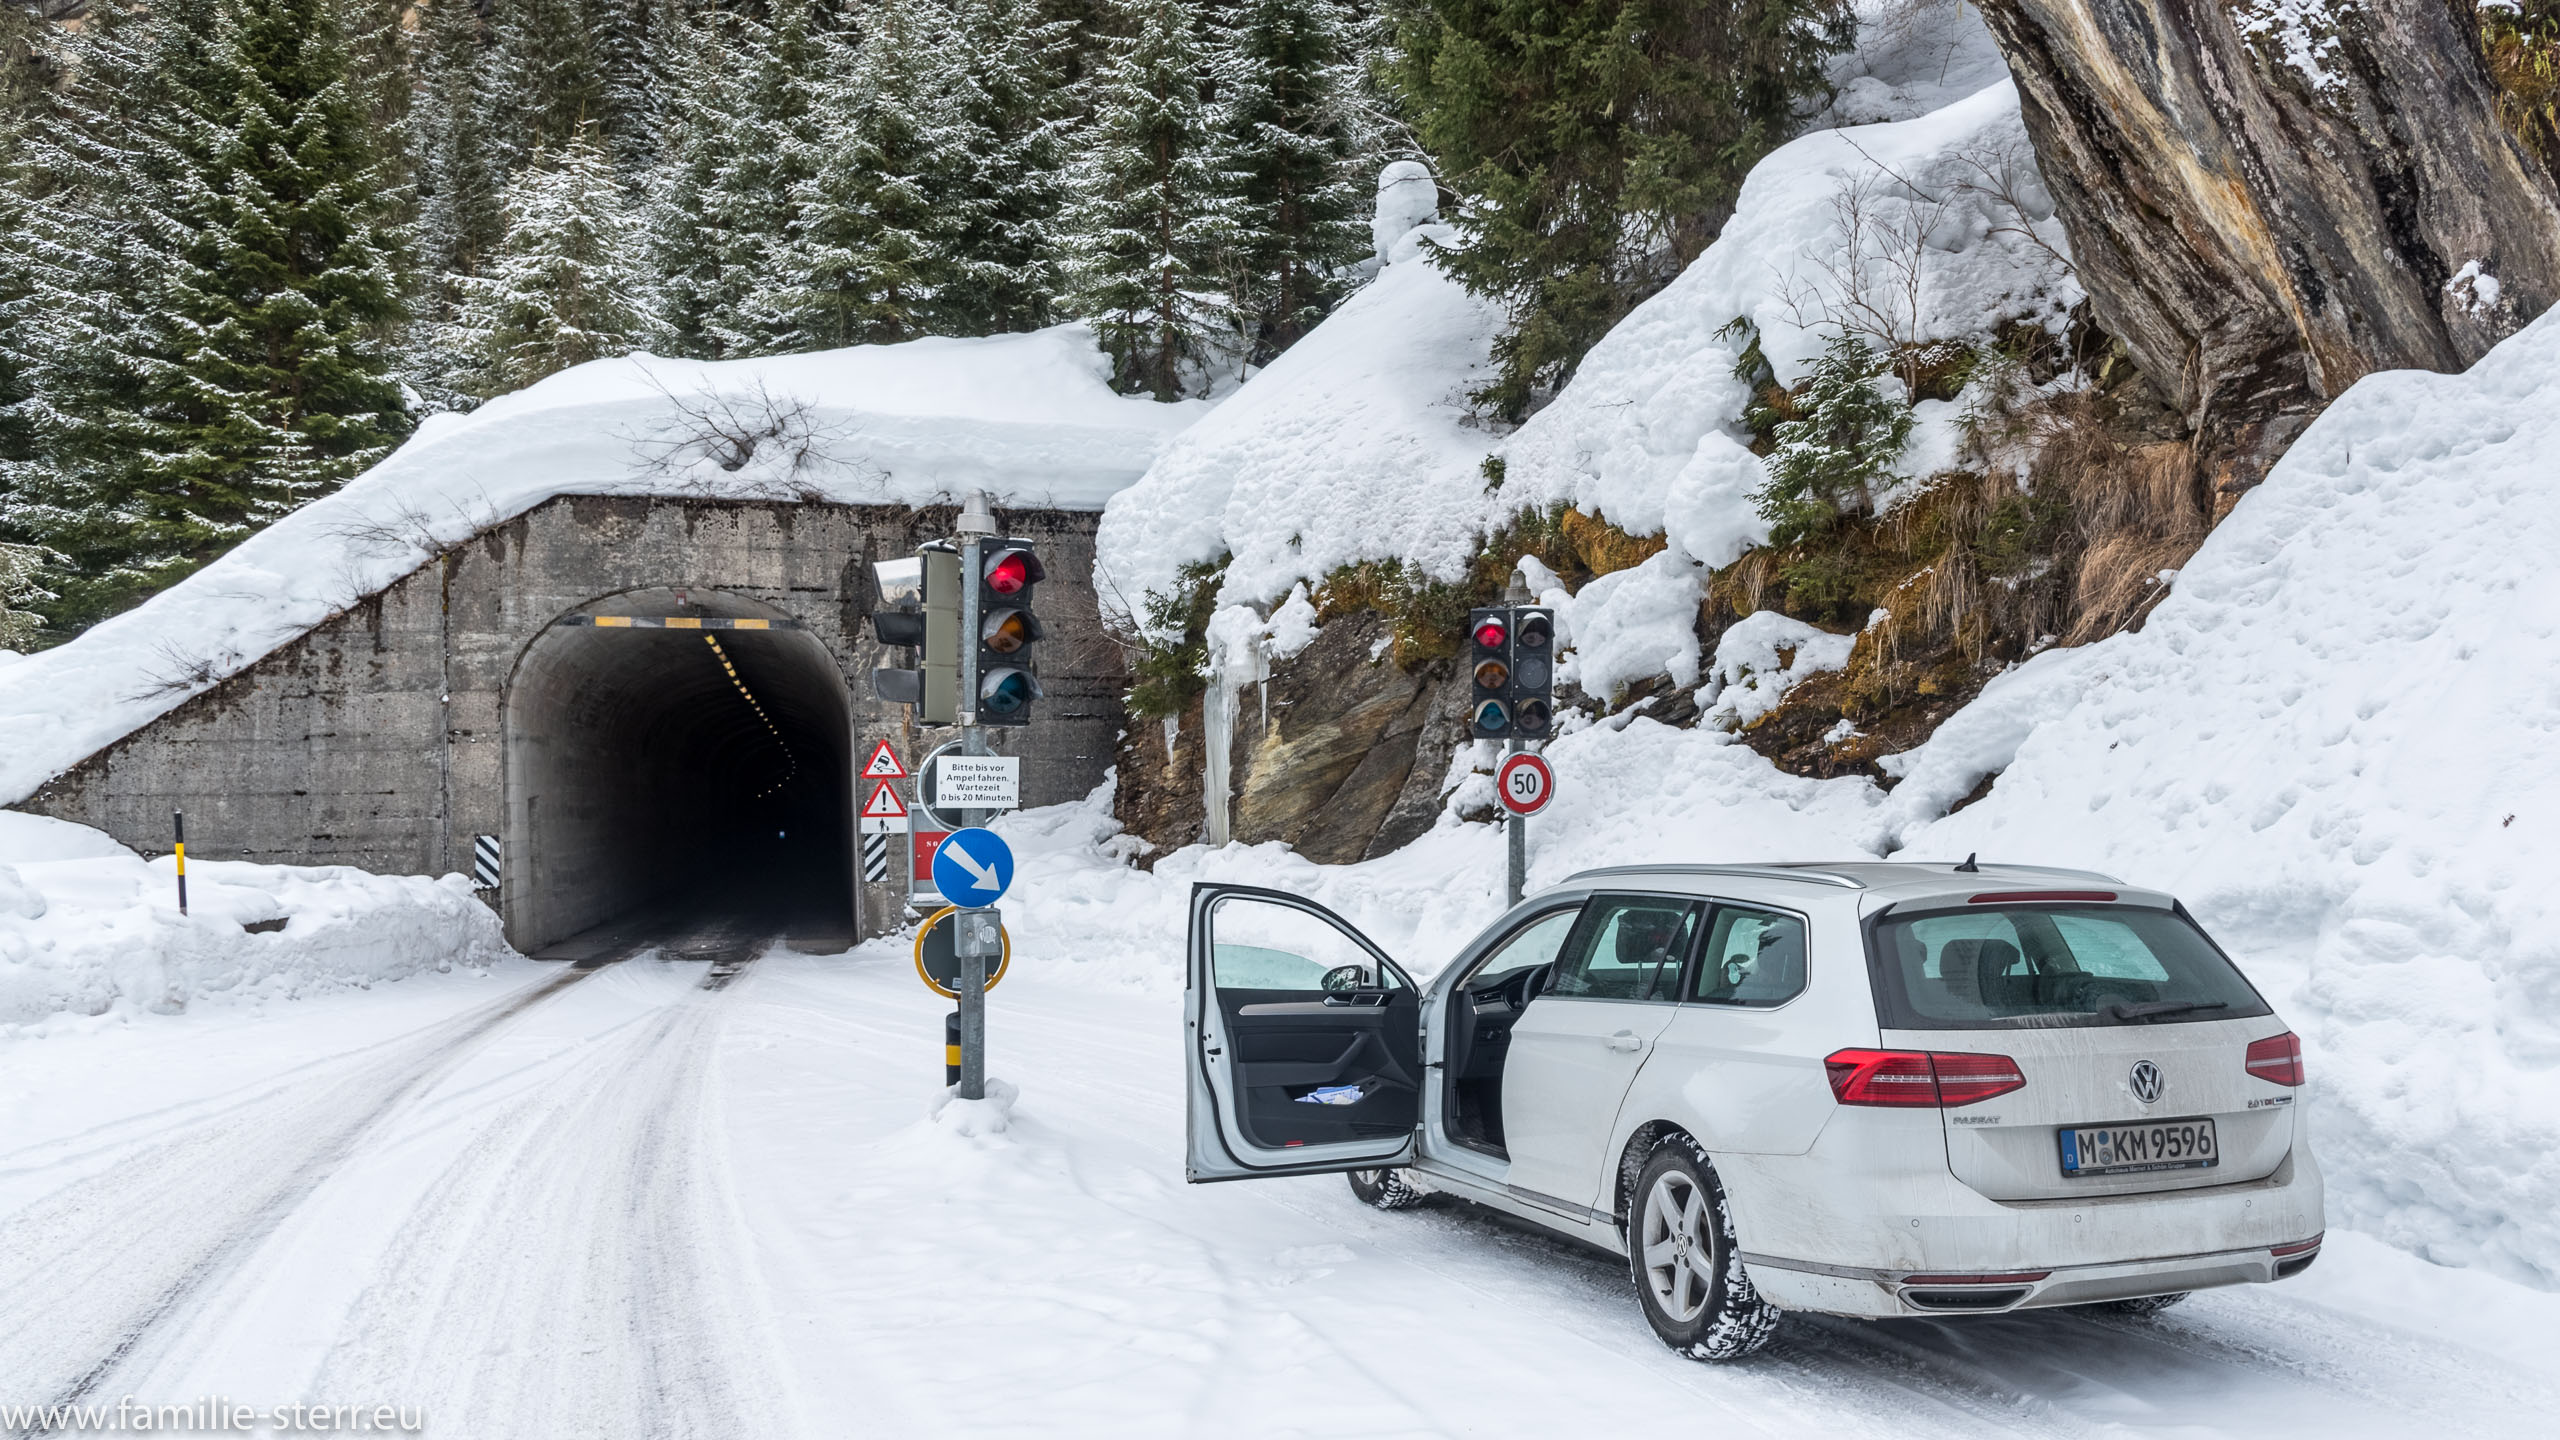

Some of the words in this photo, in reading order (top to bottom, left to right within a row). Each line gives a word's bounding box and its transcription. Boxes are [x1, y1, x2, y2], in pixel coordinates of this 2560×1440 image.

[952, 763, 974, 771] Bitte
[975, 763, 988, 771] bis
[946, 774, 976, 782] Ampel
[977, 774, 1009, 782] fahren.
[1514, 773, 1536, 794] 50
[948, 793, 961, 801] bis
[962, 793, 973, 801] 20
[975, 793, 1014, 801] Minuten.
[1953, 1116, 2001, 1125] PASSAT
[2078, 1133, 2097, 1164] M
[2067, 1154, 2074, 1163] D
